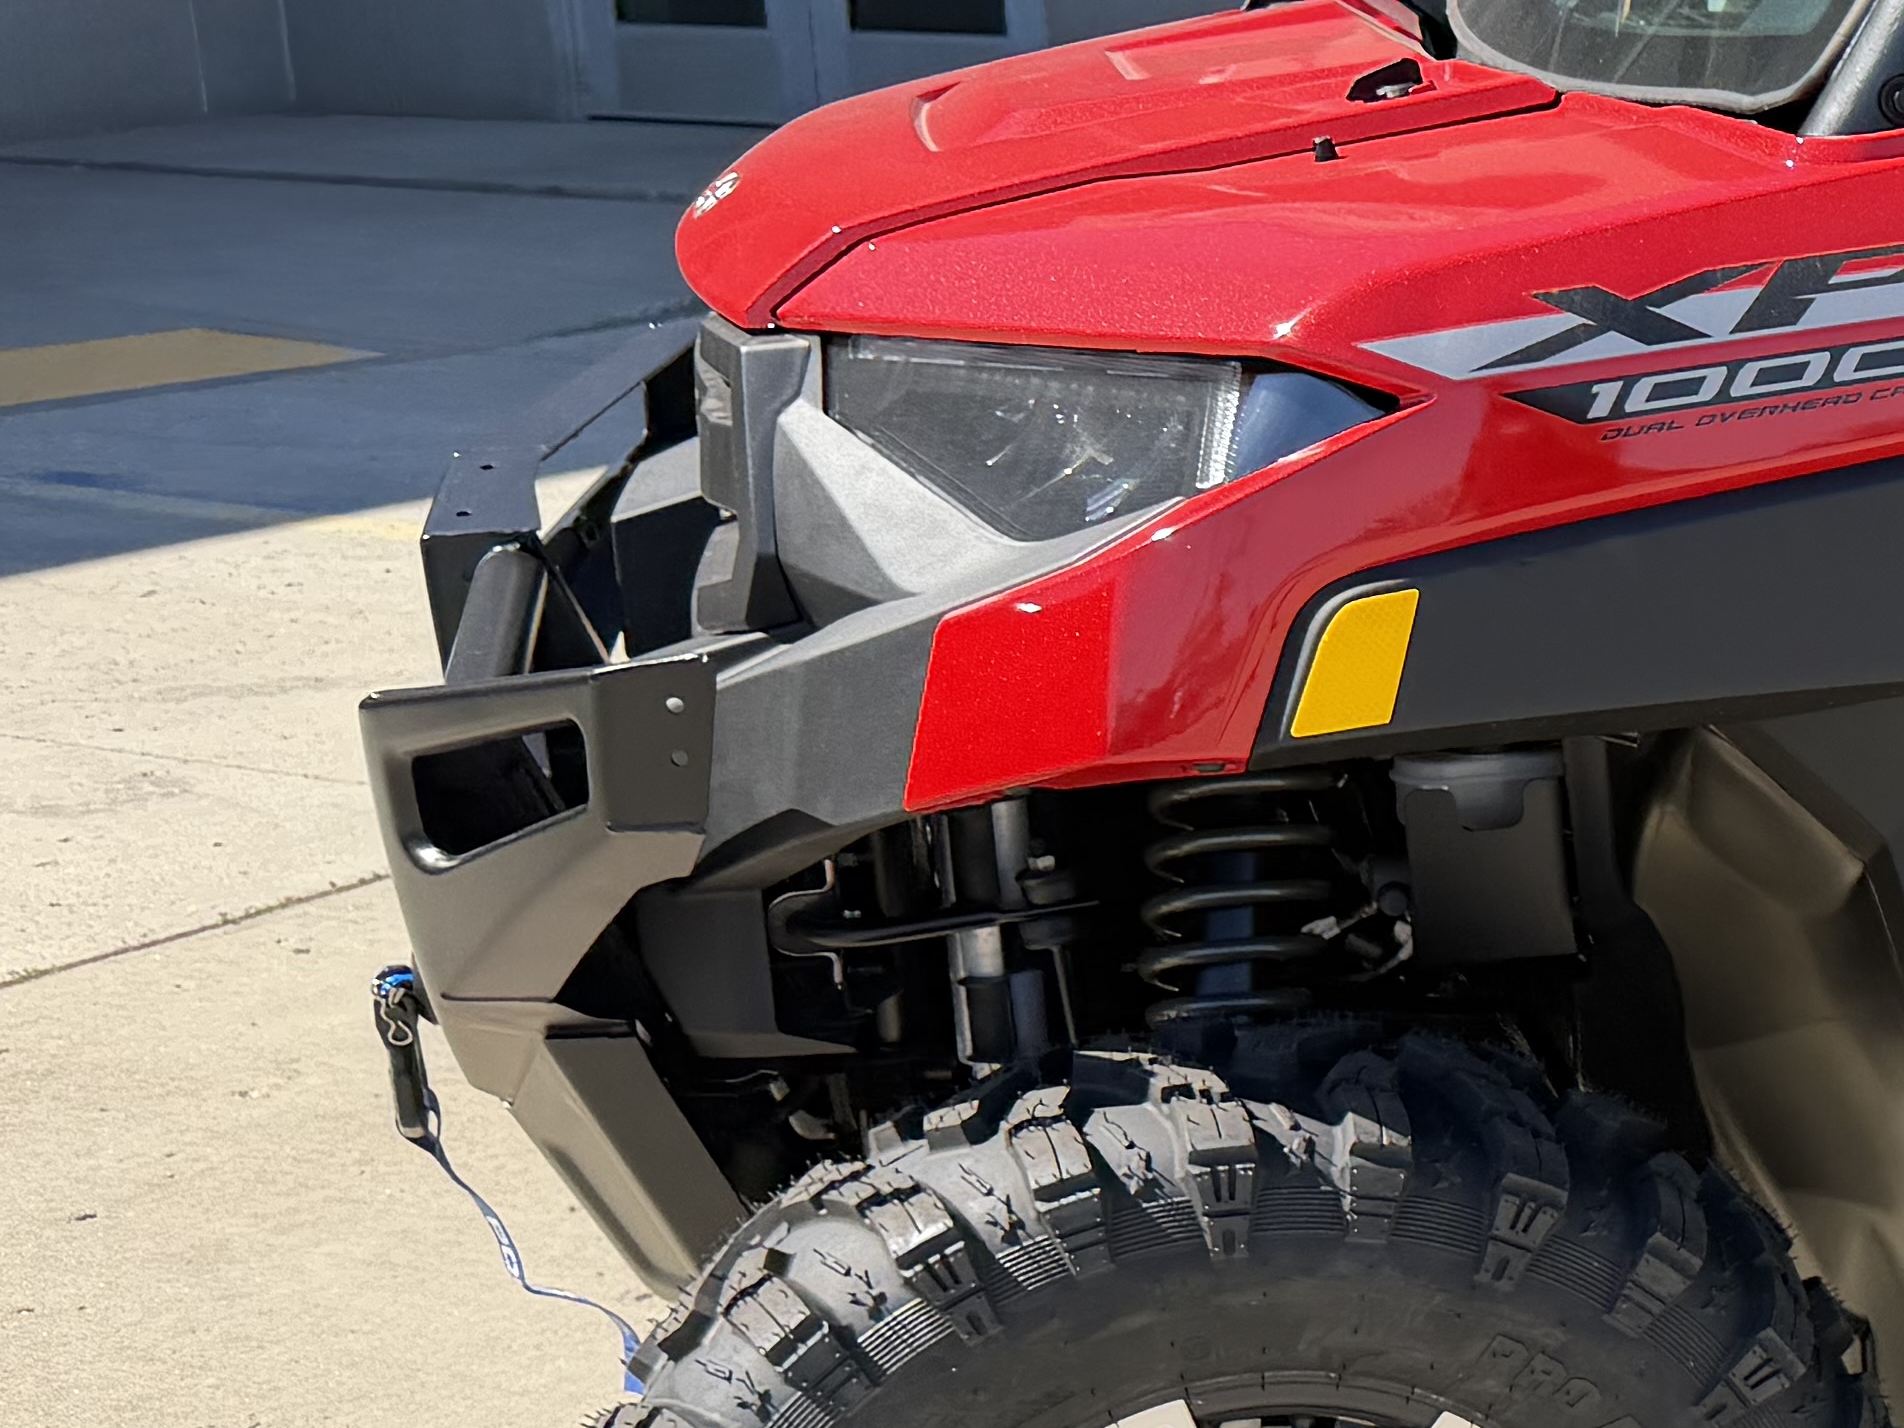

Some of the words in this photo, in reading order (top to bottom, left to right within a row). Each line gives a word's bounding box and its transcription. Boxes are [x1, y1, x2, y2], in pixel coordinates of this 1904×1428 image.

[1600, 419, 1684, 441] DUAL
[1695, 390, 1864, 429] OVERHEAD
[1474, 1331, 1602, 1409] PRO
